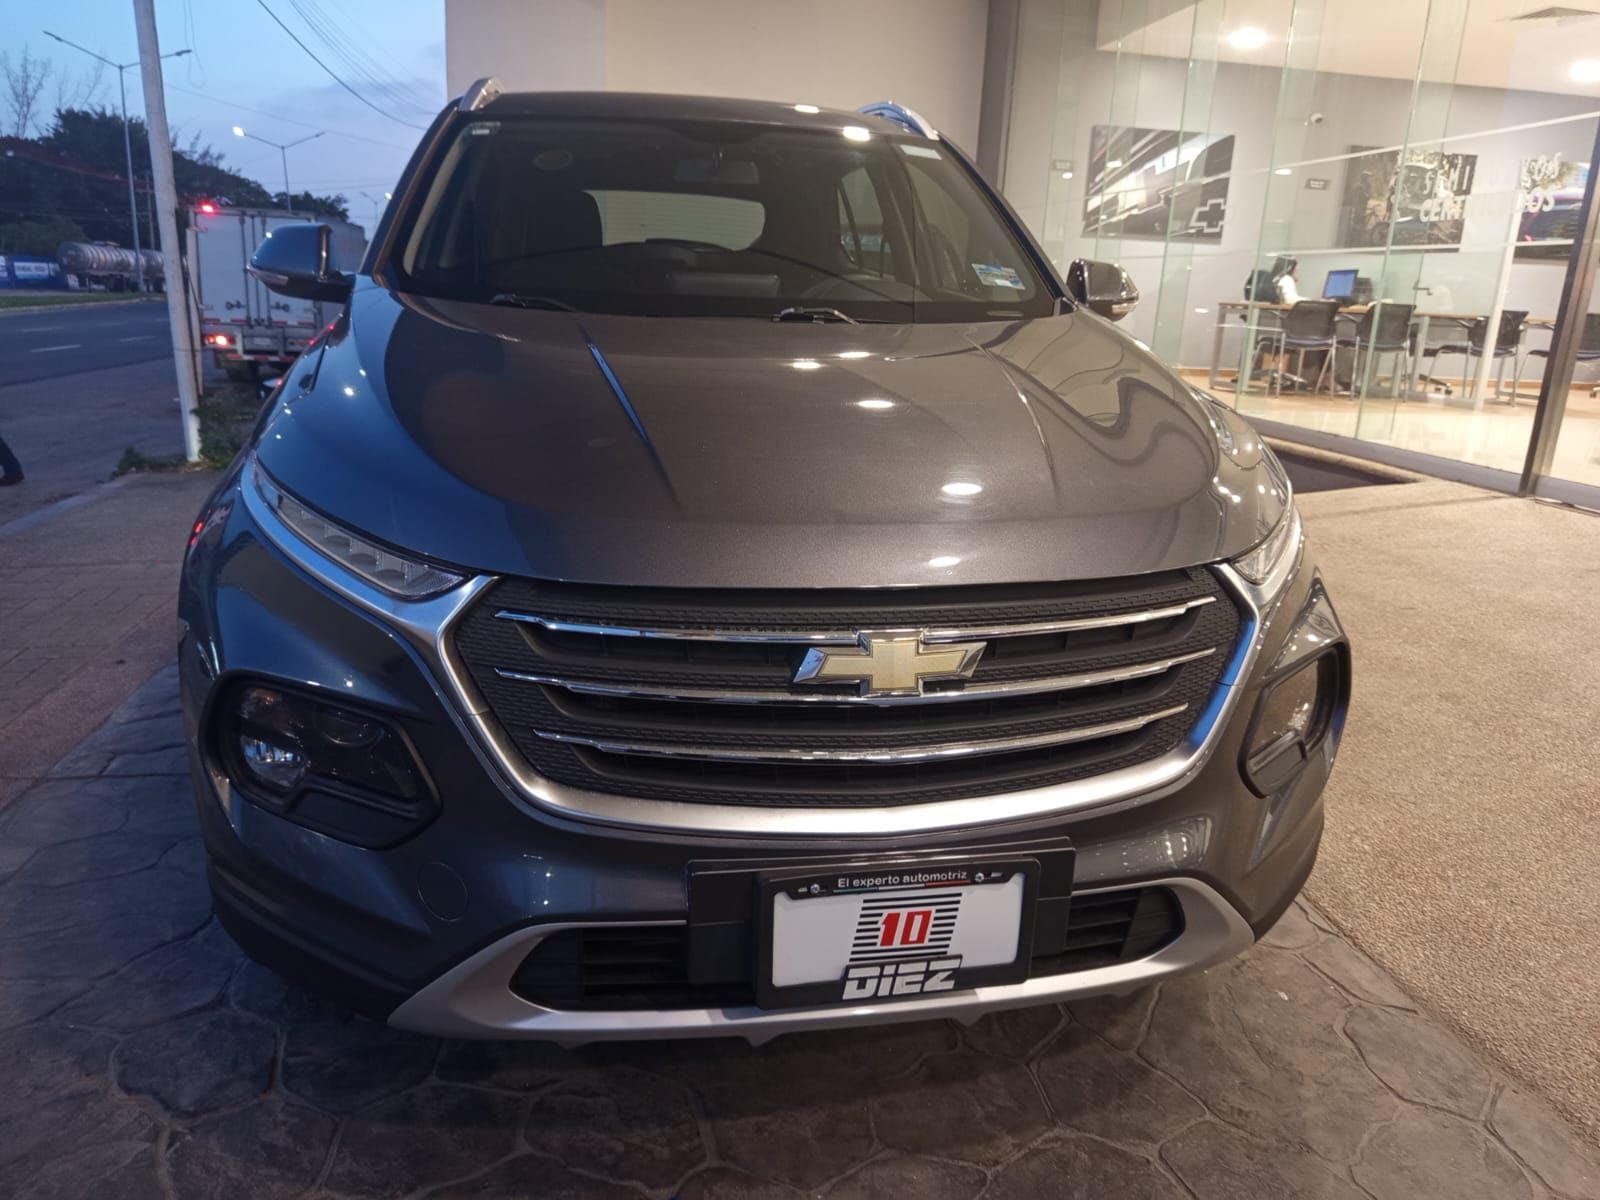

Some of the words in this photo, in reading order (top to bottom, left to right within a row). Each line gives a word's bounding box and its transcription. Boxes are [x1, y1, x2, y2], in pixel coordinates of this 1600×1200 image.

[837, 877, 850, 889] El
[852, 874, 900, 889] experto
[902, 870, 968, 884] automotriz
[879, 910, 933, 947] 10
